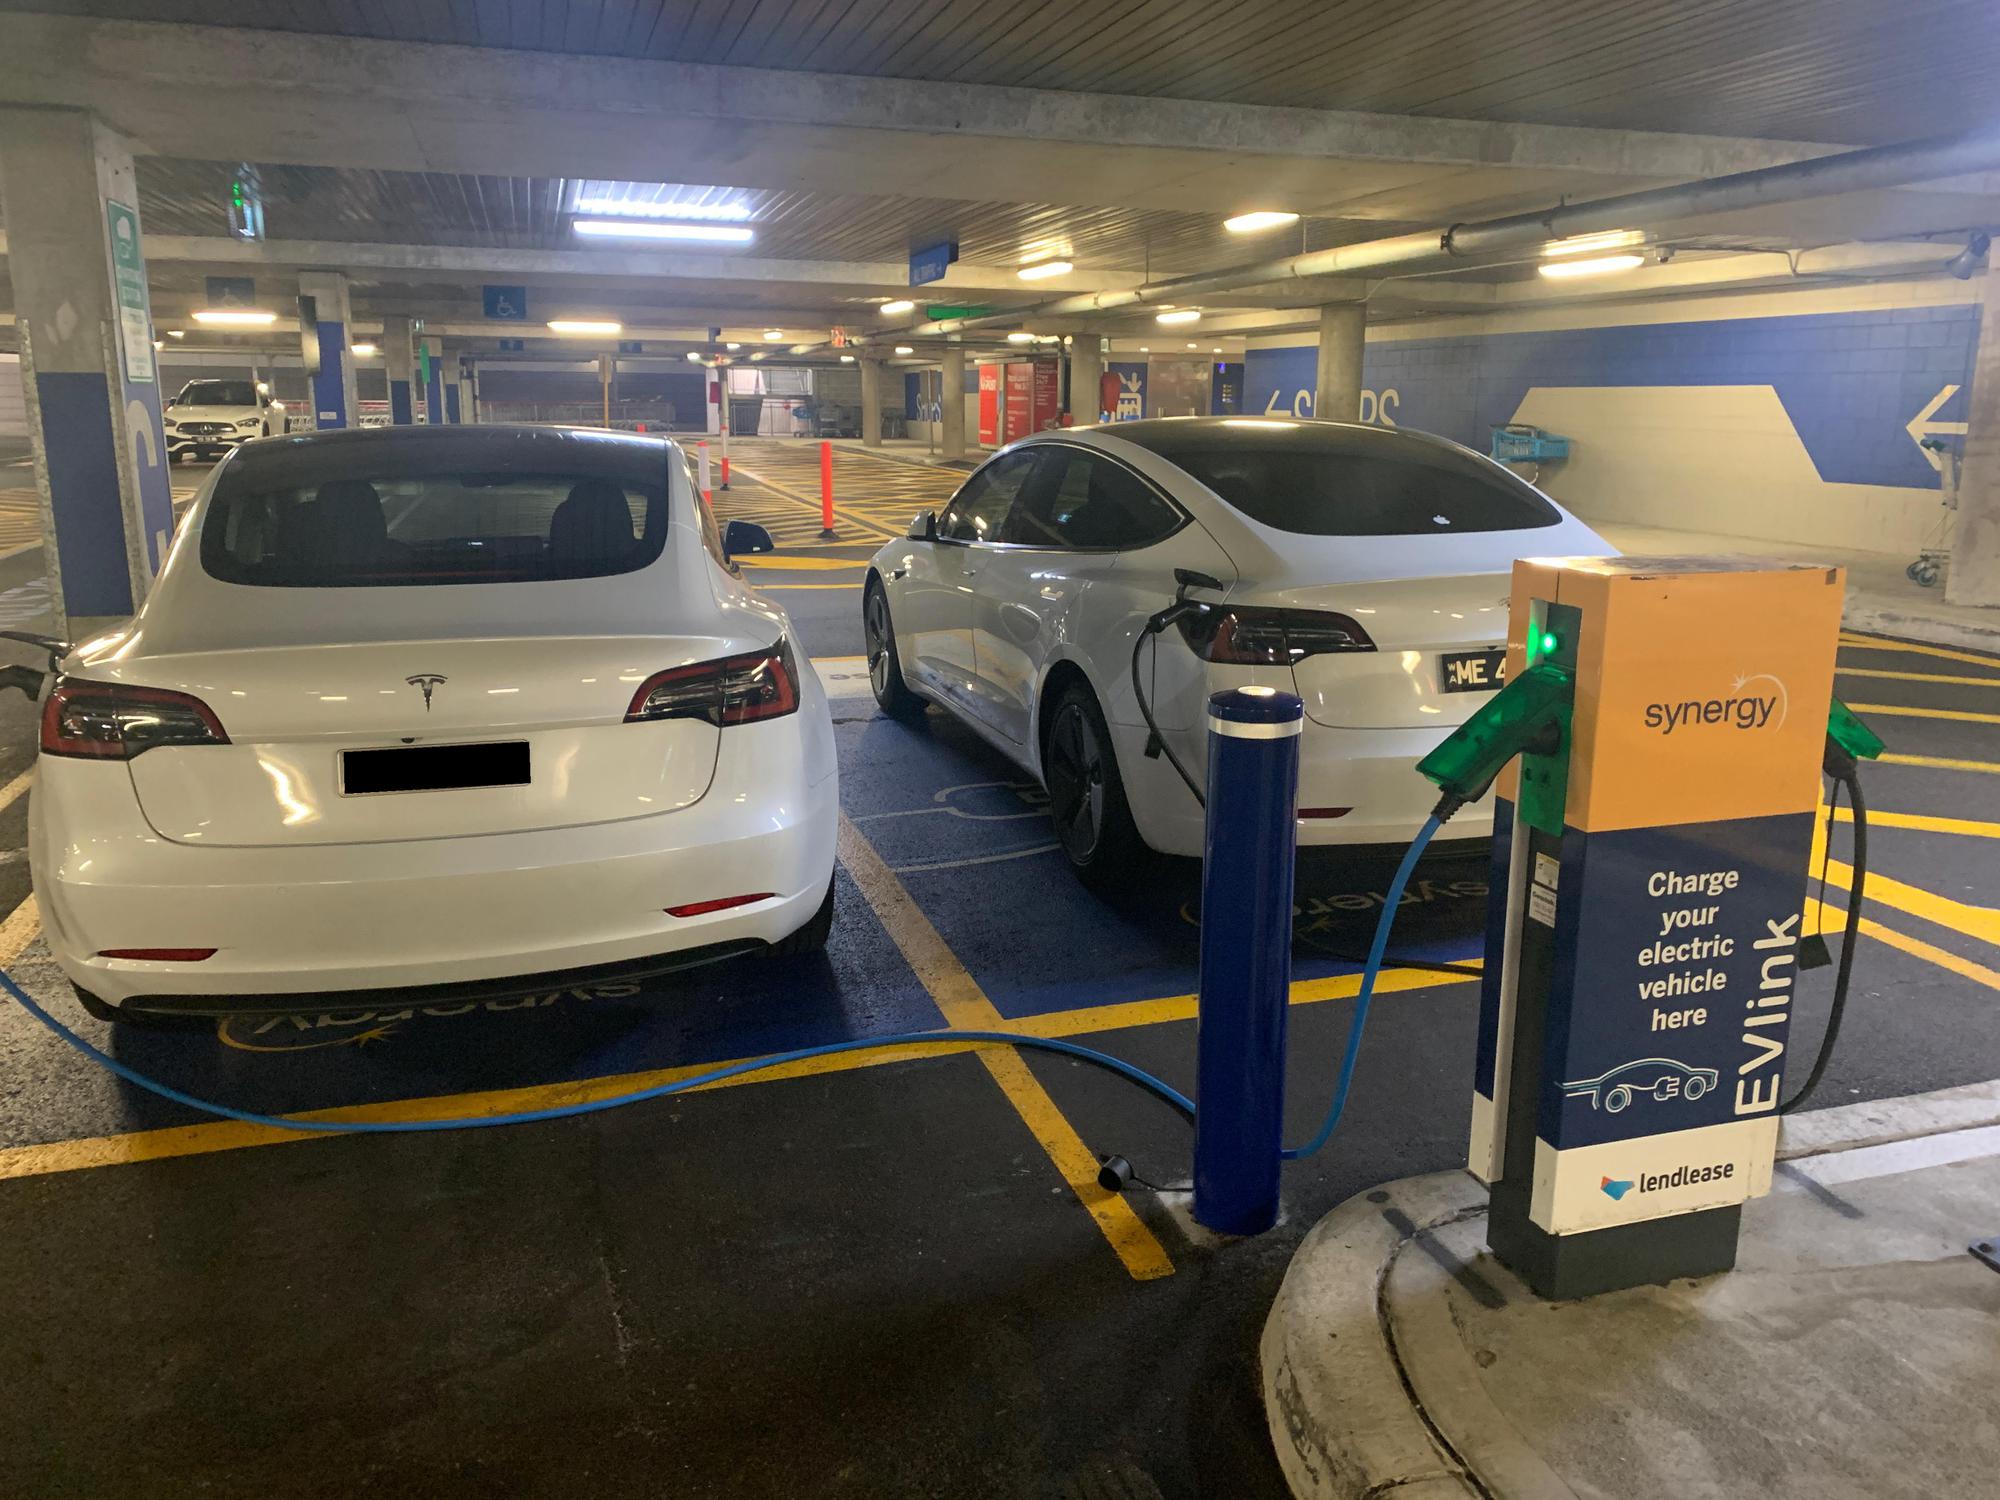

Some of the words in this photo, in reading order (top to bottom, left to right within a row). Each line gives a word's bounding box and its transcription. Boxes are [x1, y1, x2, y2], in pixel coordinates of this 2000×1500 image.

[1456, 659, 1489, 685] ME
[1644, 697, 1777, 735] synergy
[1648, 870, 1739, 897] Charge
[1659, 906, 1720, 936] your
[1638, 934, 1735, 966] electric
[1638, 968, 1727, 1000] vehicle
[1651, 1007, 1708, 1031] here
[1734, 913, 1800, 1115] EVlink
[1639, 1162, 1734, 1193] lendlease
